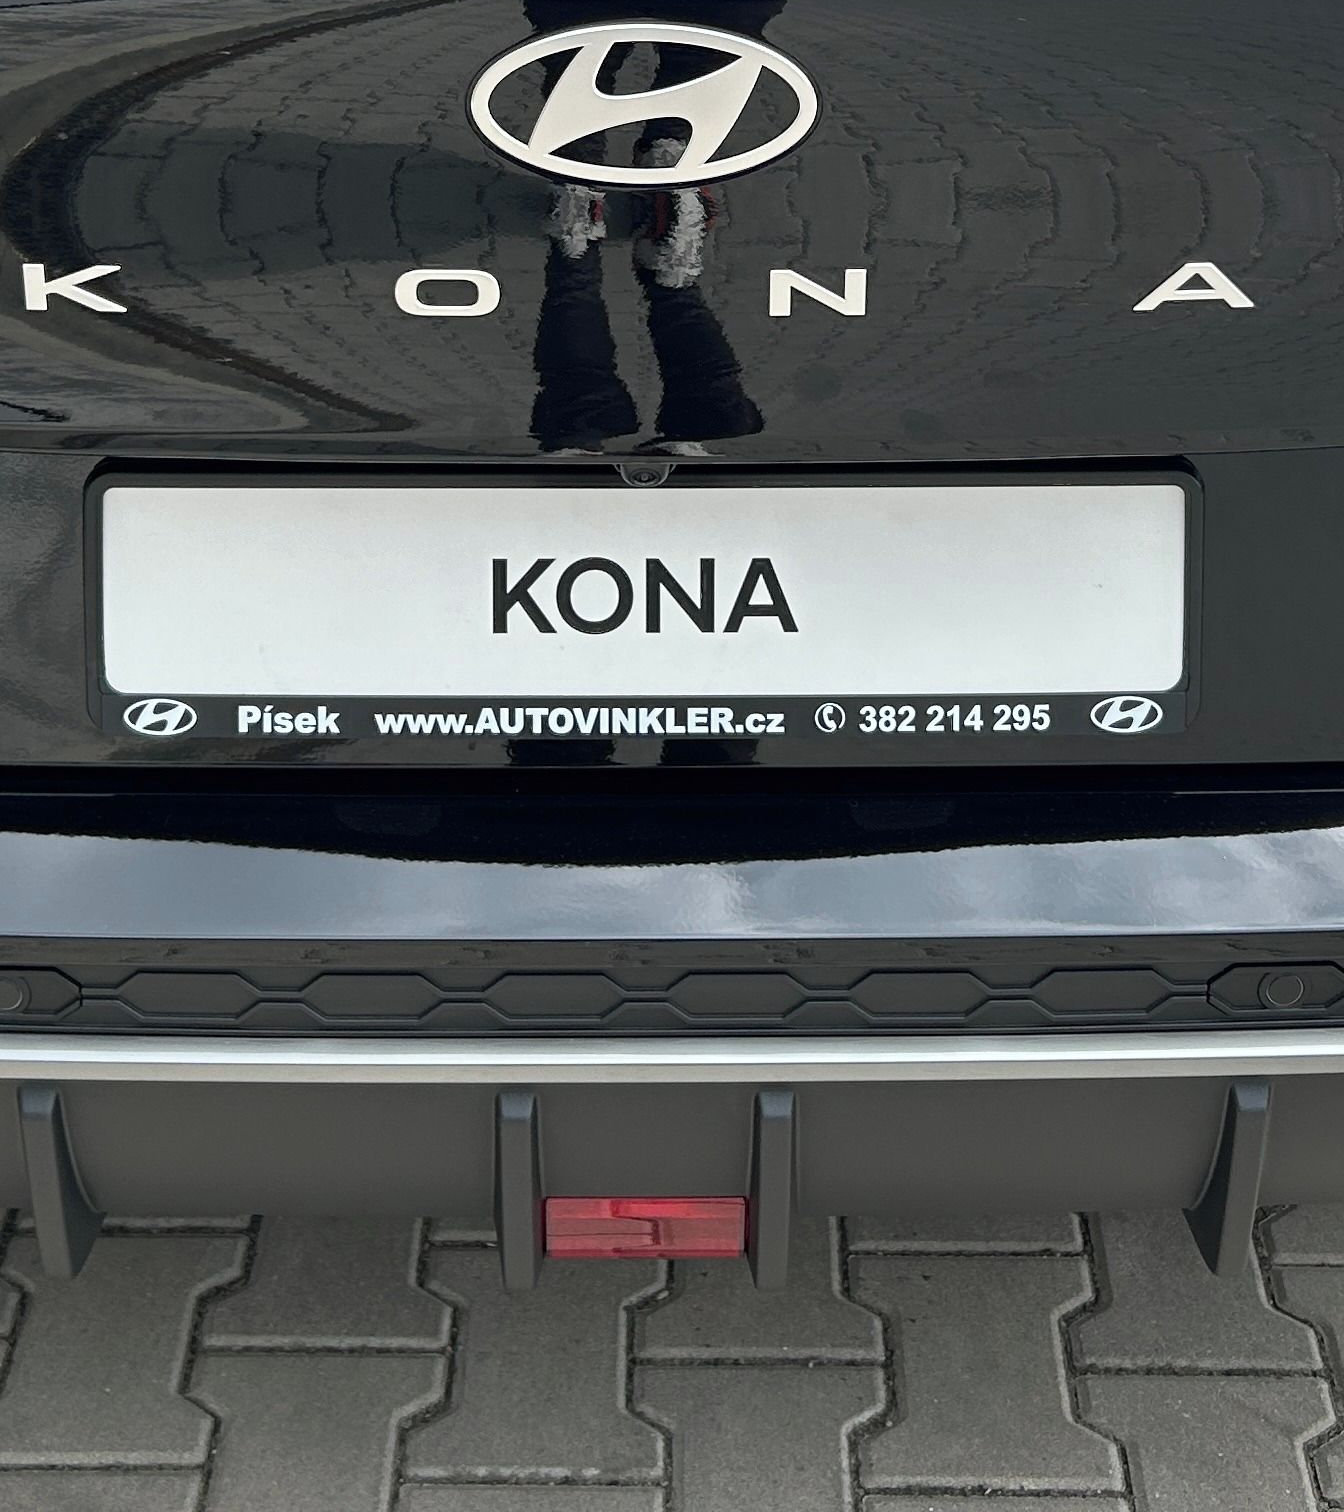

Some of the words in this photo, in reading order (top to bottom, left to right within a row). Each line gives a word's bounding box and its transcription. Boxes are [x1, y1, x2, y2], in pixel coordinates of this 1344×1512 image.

[22, 261, 1256, 317] KONA
[492, 556, 800, 635] KONA
[237, 704, 341, 734] Písek
[374, 706, 786, 735] www.AUTOVINKLER.cz
[858, 704, 917, 733] 382
[925, 704, 985, 733] 214
[992, 703, 1051, 732] 295
